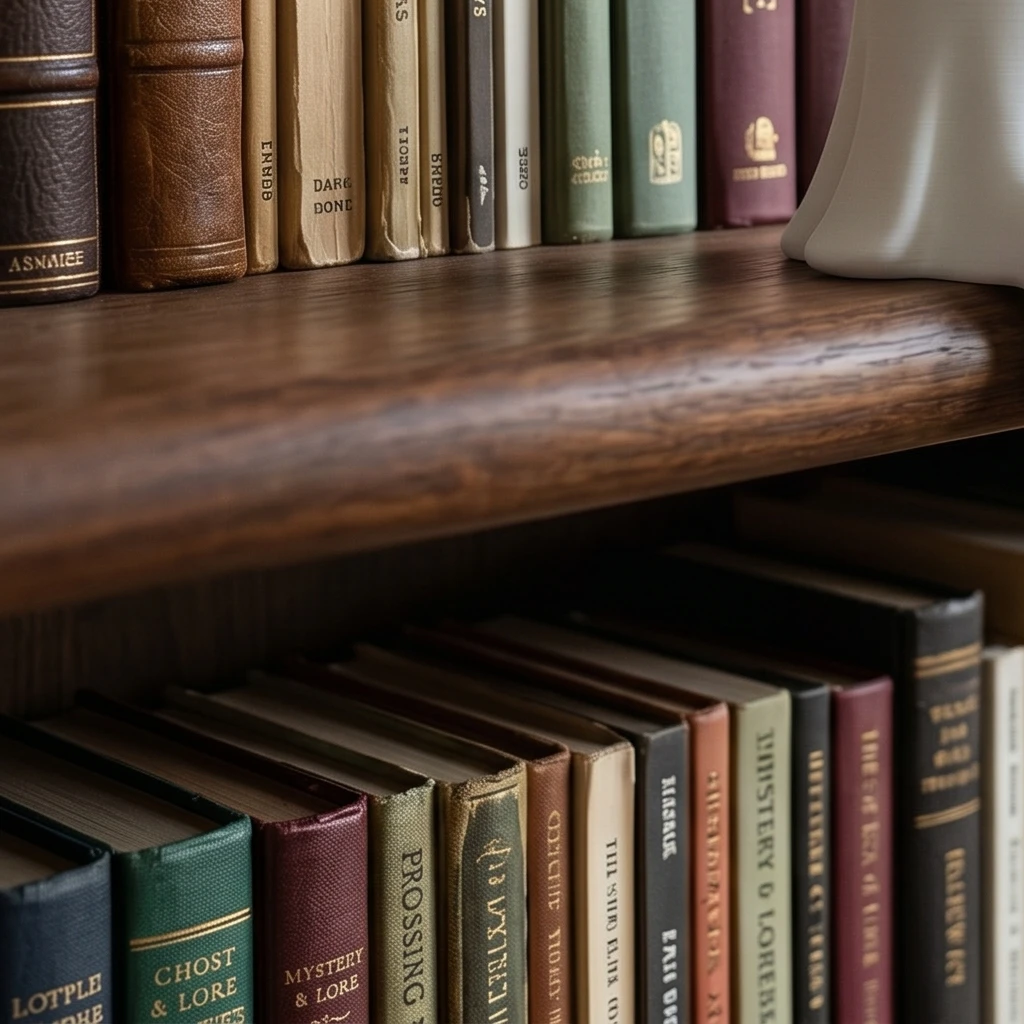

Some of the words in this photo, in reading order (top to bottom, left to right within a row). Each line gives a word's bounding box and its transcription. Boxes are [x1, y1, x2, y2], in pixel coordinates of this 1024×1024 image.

[284, 947, 364, 985] MYSTERY
[151, 999, 167, 1018] &
[179, 976, 238, 1012] LORE
[296, 992, 308, 1008] &
[316, 974, 360, 1003] LORE
